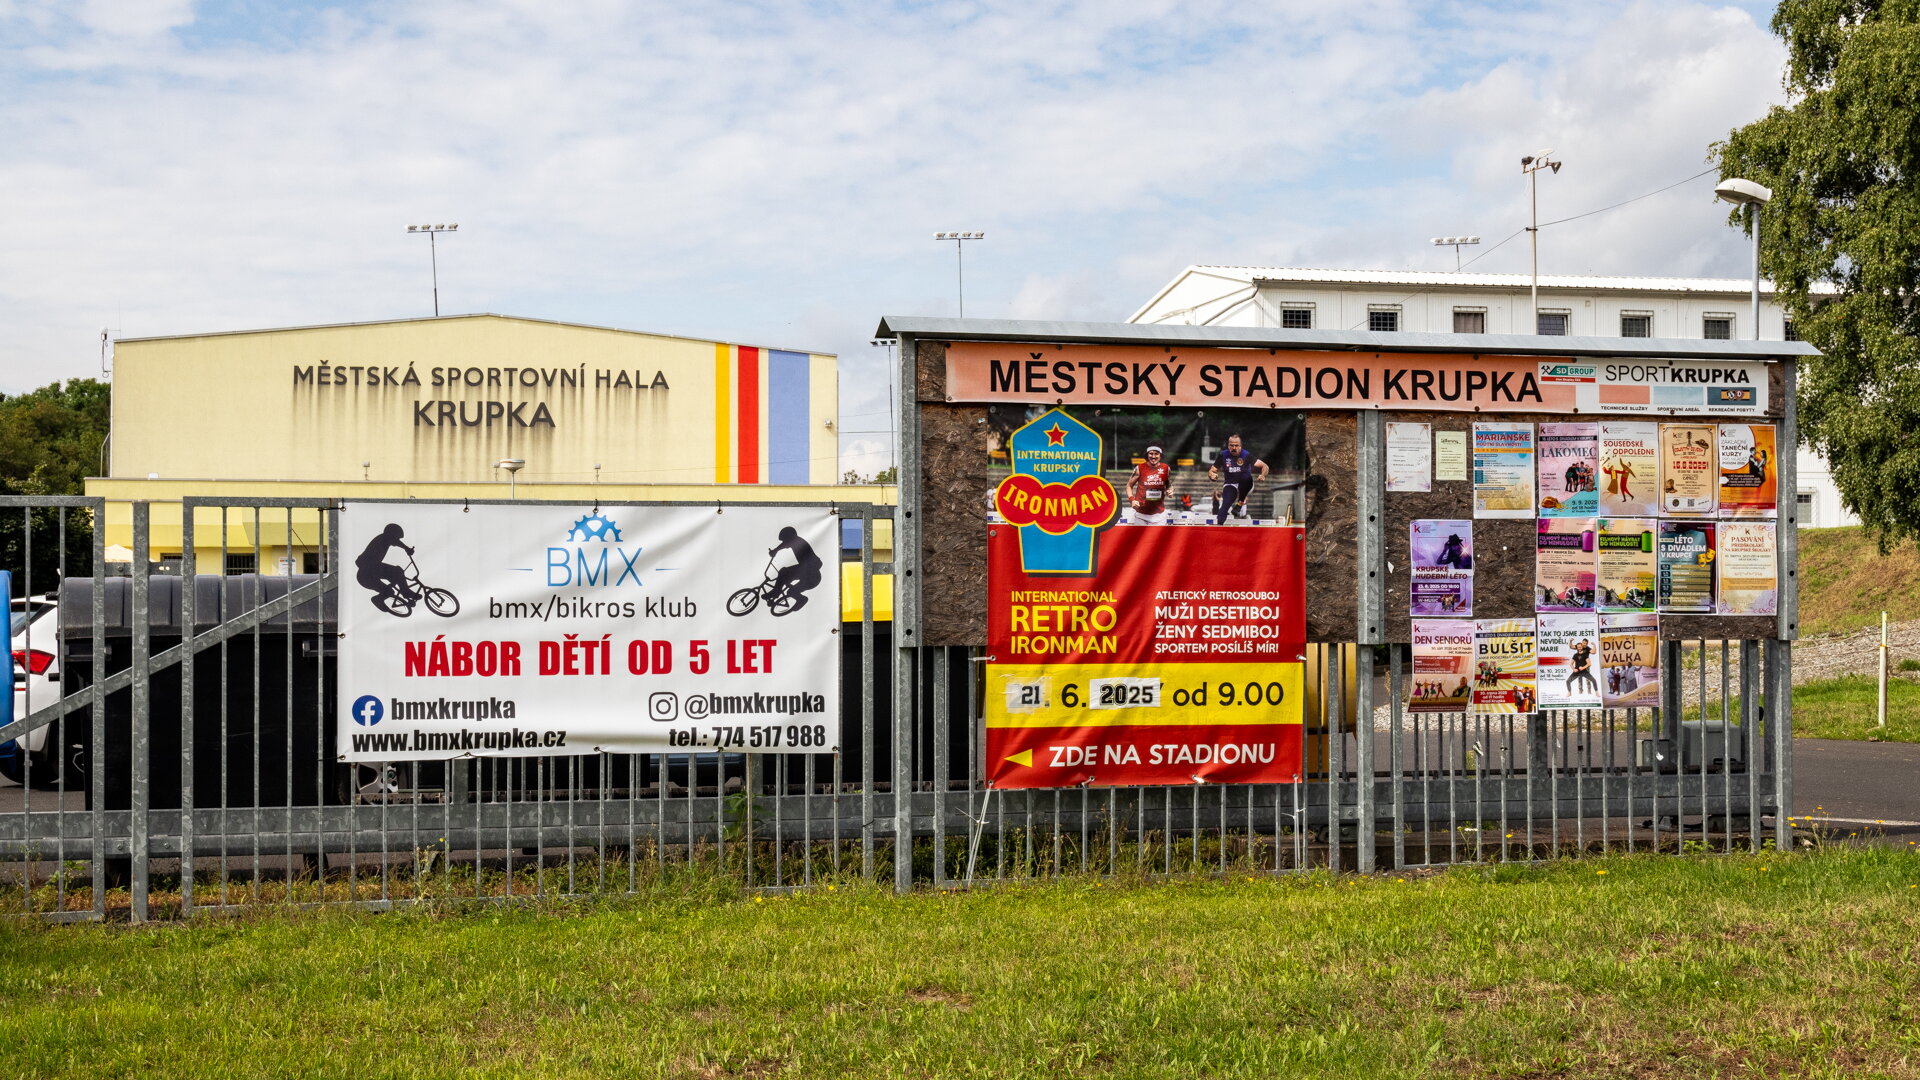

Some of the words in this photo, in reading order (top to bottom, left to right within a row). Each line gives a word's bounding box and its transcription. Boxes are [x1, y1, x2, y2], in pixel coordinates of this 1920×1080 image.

[293, 360, 421, 386] MĚSTSKÁ
[432, 363, 585, 387] SPORTOVNÍ
[596, 369, 669, 389] HALA
[990, 352, 1185, 395] MĚSTSKÝ
[1200, 363, 1370, 400] STADION
[1384, 369, 1543, 402] KRUPKA
[1605, 365, 1749, 383] SPORTKRUPKA
[414, 400, 556, 427] KRUPKA
[1476, 432, 1530, 441] MARIÁNSKÉ
[1017, 450, 1096, 461] INTERNATIONAL
[1541, 447, 1596, 457] LAKOMEC
[1033, 461, 1080, 473] KRUPSKÝ
[1003, 484, 1109, 517] IRONMAN
[1674, 534, 1693, 543] LÉTO
[546, 546, 643, 587] BMX
[1011, 591, 1117, 603] INTERNATIONAL
[1155, 589, 1206, 600] ATLETICKÝ
[1210, 591, 1280, 600] RETROSOUBOJ
[489, 594, 635, 622] bmx/bikros
[646, 596, 697, 618] klub
[1155, 603, 1193, 620] MUŽI
[1198, 606, 1280, 620] DESETIBOJ
[1011, 605, 1117, 632] RETRO
[1156, 622, 1197, 639] ŽENY
[1201, 625, 1280, 639] SEDMIBOJ
[1415, 636, 1432, 644] DEN
[1434, 633, 1472, 644] SENIORŮ
[1011, 635, 1117, 654] IRONMAN
[1155, 643, 1209, 654] SPORTEM
[1211, 640, 1254, 654] POSÍLÍŠ
[1256, 640, 1279, 653] MÍR!
[1479, 640, 1533, 654] BULŠIT
[1603, 637, 1635, 650] DÍVČÍ
[404, 634, 521, 677] NÁBOR
[539, 633, 612, 676] DĚTÍ
[628, 639, 673, 674] OD
[690, 639, 710, 674] 5
[726, 639, 777, 674] LET
[1603, 651, 1641, 663] VÁLKA
[1061, 683, 1087, 708] 6.
[1099, 684, 1155, 706] 2025
[1172, 682, 1207, 706] od
[1218, 681, 1284, 706] 9.00
[391, 698, 516, 726] bmxkrupka
[684, 692, 825, 719] @bmxkrupka
[352, 727, 566, 754] www.bmxkrupka.cz
[669, 727, 708, 747] tel.:
[712, 726, 747, 748] 774
[750, 726, 784, 747] 517
[786, 725, 826, 747] 988
[1049, 746, 1096, 767] ZDE
[1104, 745, 1142, 765] NA
[1149, 743, 1275, 765] STADIONU
